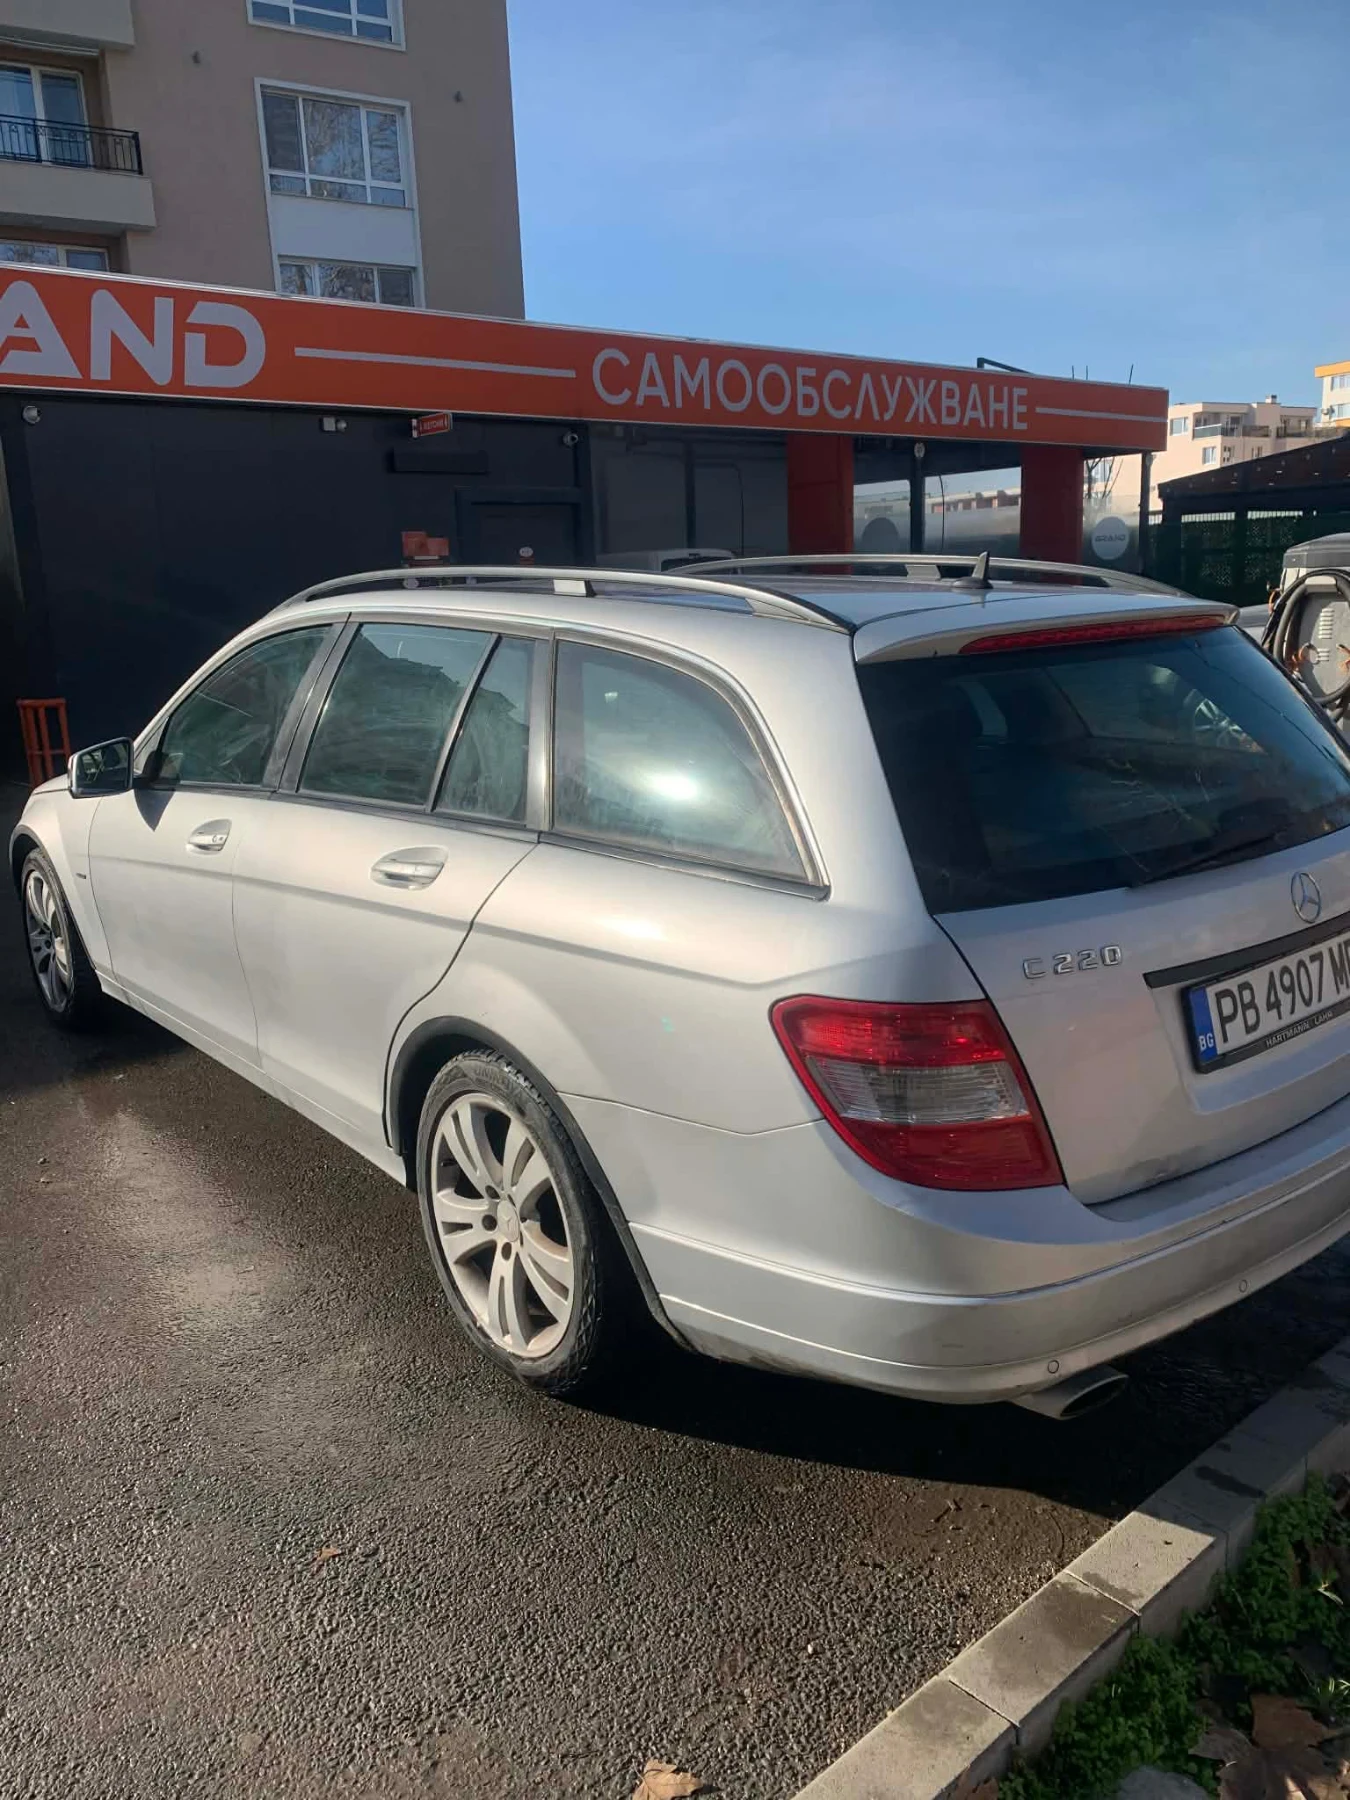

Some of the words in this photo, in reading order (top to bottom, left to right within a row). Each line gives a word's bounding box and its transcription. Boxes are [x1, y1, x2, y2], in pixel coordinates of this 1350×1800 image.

[0, 280, 266, 389] AND
[592, 348, 1028, 431] САМООБСЛУЖВАНЕ
[1022, 957, 1047, 979] C
[1053, 944, 1122, 975] 220
[1215, 980, 1261, 1043] PB
[1266, 952, 1324, 1020] 4907
[1198, 1033, 1214, 1051] BG
[1265, 1021, 1311, 1048] HARTMANN
